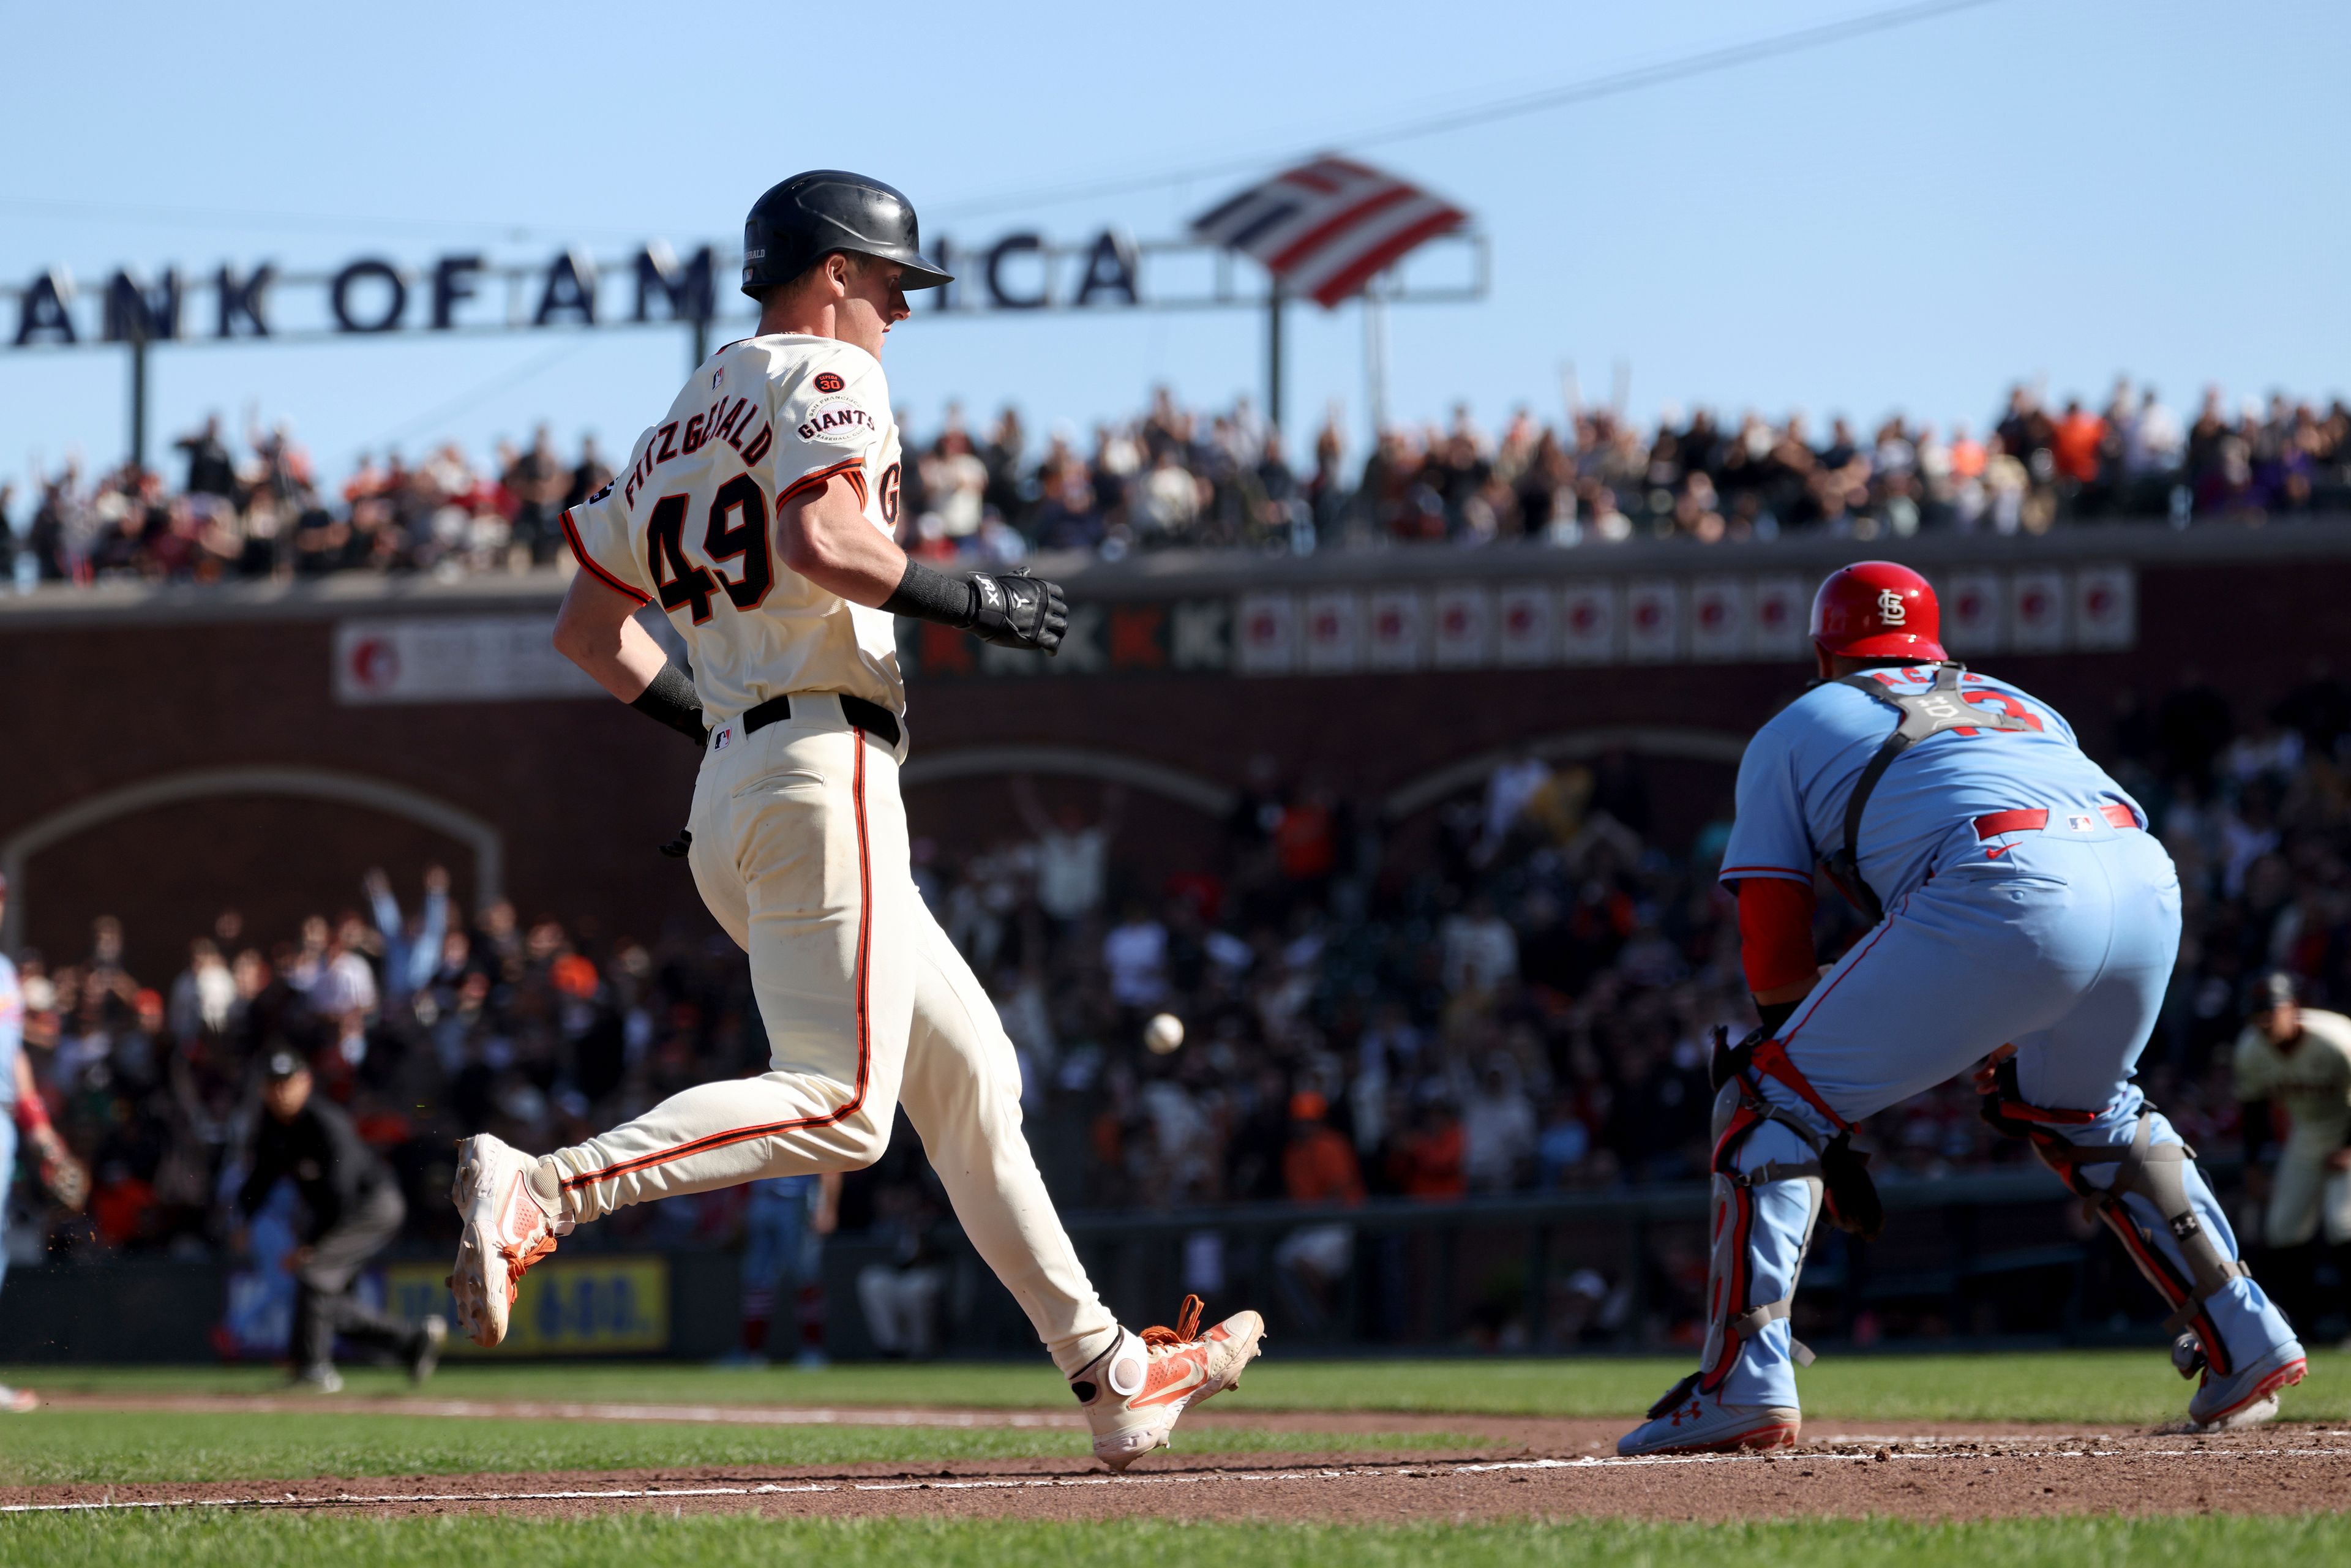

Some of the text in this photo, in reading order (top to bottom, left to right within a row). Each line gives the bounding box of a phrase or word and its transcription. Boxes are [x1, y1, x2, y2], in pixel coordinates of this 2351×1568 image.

[745, 249, 765, 260] ERALD
[15, 230, 1142, 345] ANK OF AMICA
[820, 380, 841, 390] 30
[808, 396, 862, 417] SAN FRANCISCO
[798, 410, 876, 439] GIANTS
[852, 427, 866, 437] CLUB
[647, 471, 774, 627] 49
[975, 574, 999, 607] JAX
[1952, 691, 2044, 737] 3
